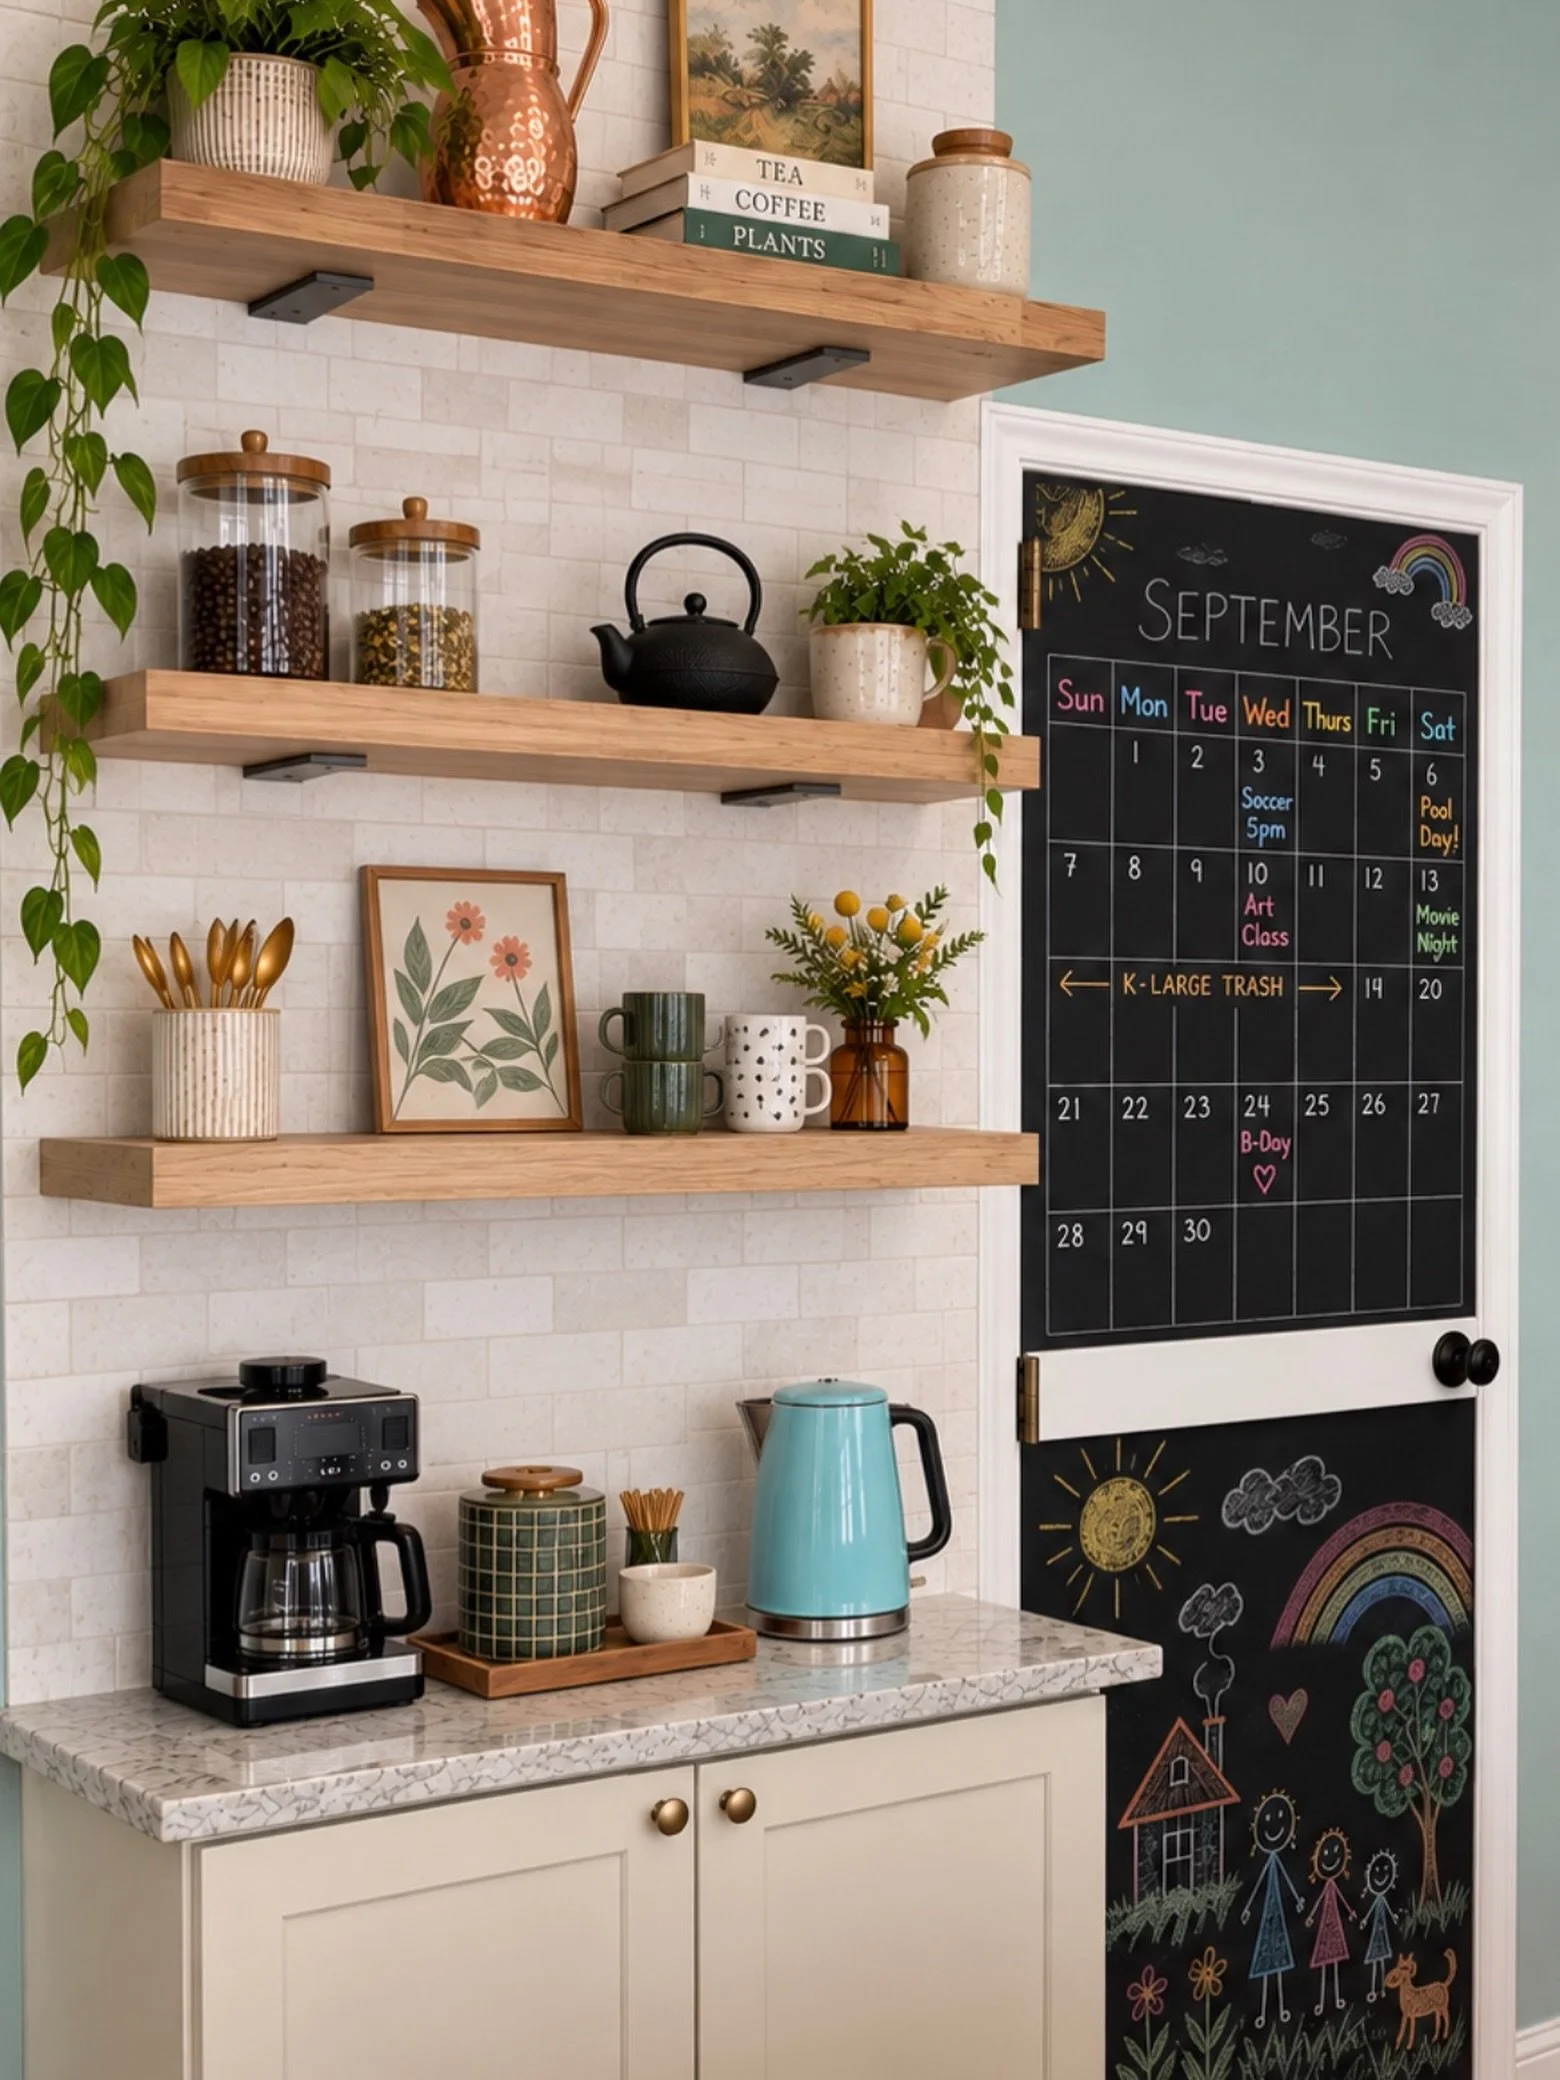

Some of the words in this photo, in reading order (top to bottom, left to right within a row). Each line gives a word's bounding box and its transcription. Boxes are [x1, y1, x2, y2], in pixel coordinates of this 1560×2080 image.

[756, 158, 804, 186] TEA
[735, 189, 826, 223] COFFEE
[732, 225, 827, 260] PLANTS
[1138, 576, 1394, 661] SEPTEMBER
[1057, 678, 1105, 713] Sun
[1120, 684, 1168, 718] Mon
[1184, 689, 1228, 724] Tue
[1242, 695, 1290, 729] Wed
[1302, 700, 1352, 733] Thurs
[1367, 706, 1396, 737] Fri
[1420, 711, 1457, 742] Sat
[1191, 744, 1204, 769] 2
[1252, 748, 1265, 774] 3
[1312, 755, 1325, 777] 4
[1369, 757, 1382, 782] 5
[1426, 762, 1438, 786] 6
[1241, 785, 1294, 811] Soccer
[1420, 795, 1453, 820] Pool
[1246, 816, 1286, 848] 5pm
[1420, 823, 1459, 856] Day!
[1063, 852, 1077, 878] 7
[1128, 854, 1142, 881] 8
[1190, 858, 1202, 883] 9
[1248, 861, 1268, 885] 10
[1309, 864, 1324, 888] 11
[1365, 867, 1383, 890] 12
[1421, 869, 1439, 892] 13
[1243, 892, 1275, 918] Art
[1416, 902, 1460, 927] Movie
[1241, 922, 1290, 947] Class
[1417, 930, 1459, 963] Night
[1221, 974, 1284, 997] TRASH
[1419, 977, 1443, 1000] 20
[1057, 1096, 1080, 1121] 21
[1122, 1095, 1149, 1120] 22
[1183, 1095, 1211, 1119] 23
[1243, 1094, 1271, 1118] 24
[1304, 1093, 1330, 1117] 25
[1361, 1092, 1386, 1115] 26
[1417, 1092, 1440, 1115] 27
[1240, 1129, 1292, 1160] B-Day
[1057, 1222, 1084, 1249] 28
[1121, 1220, 1147, 1246] 29
[1183, 1217, 1211, 1243] 30
